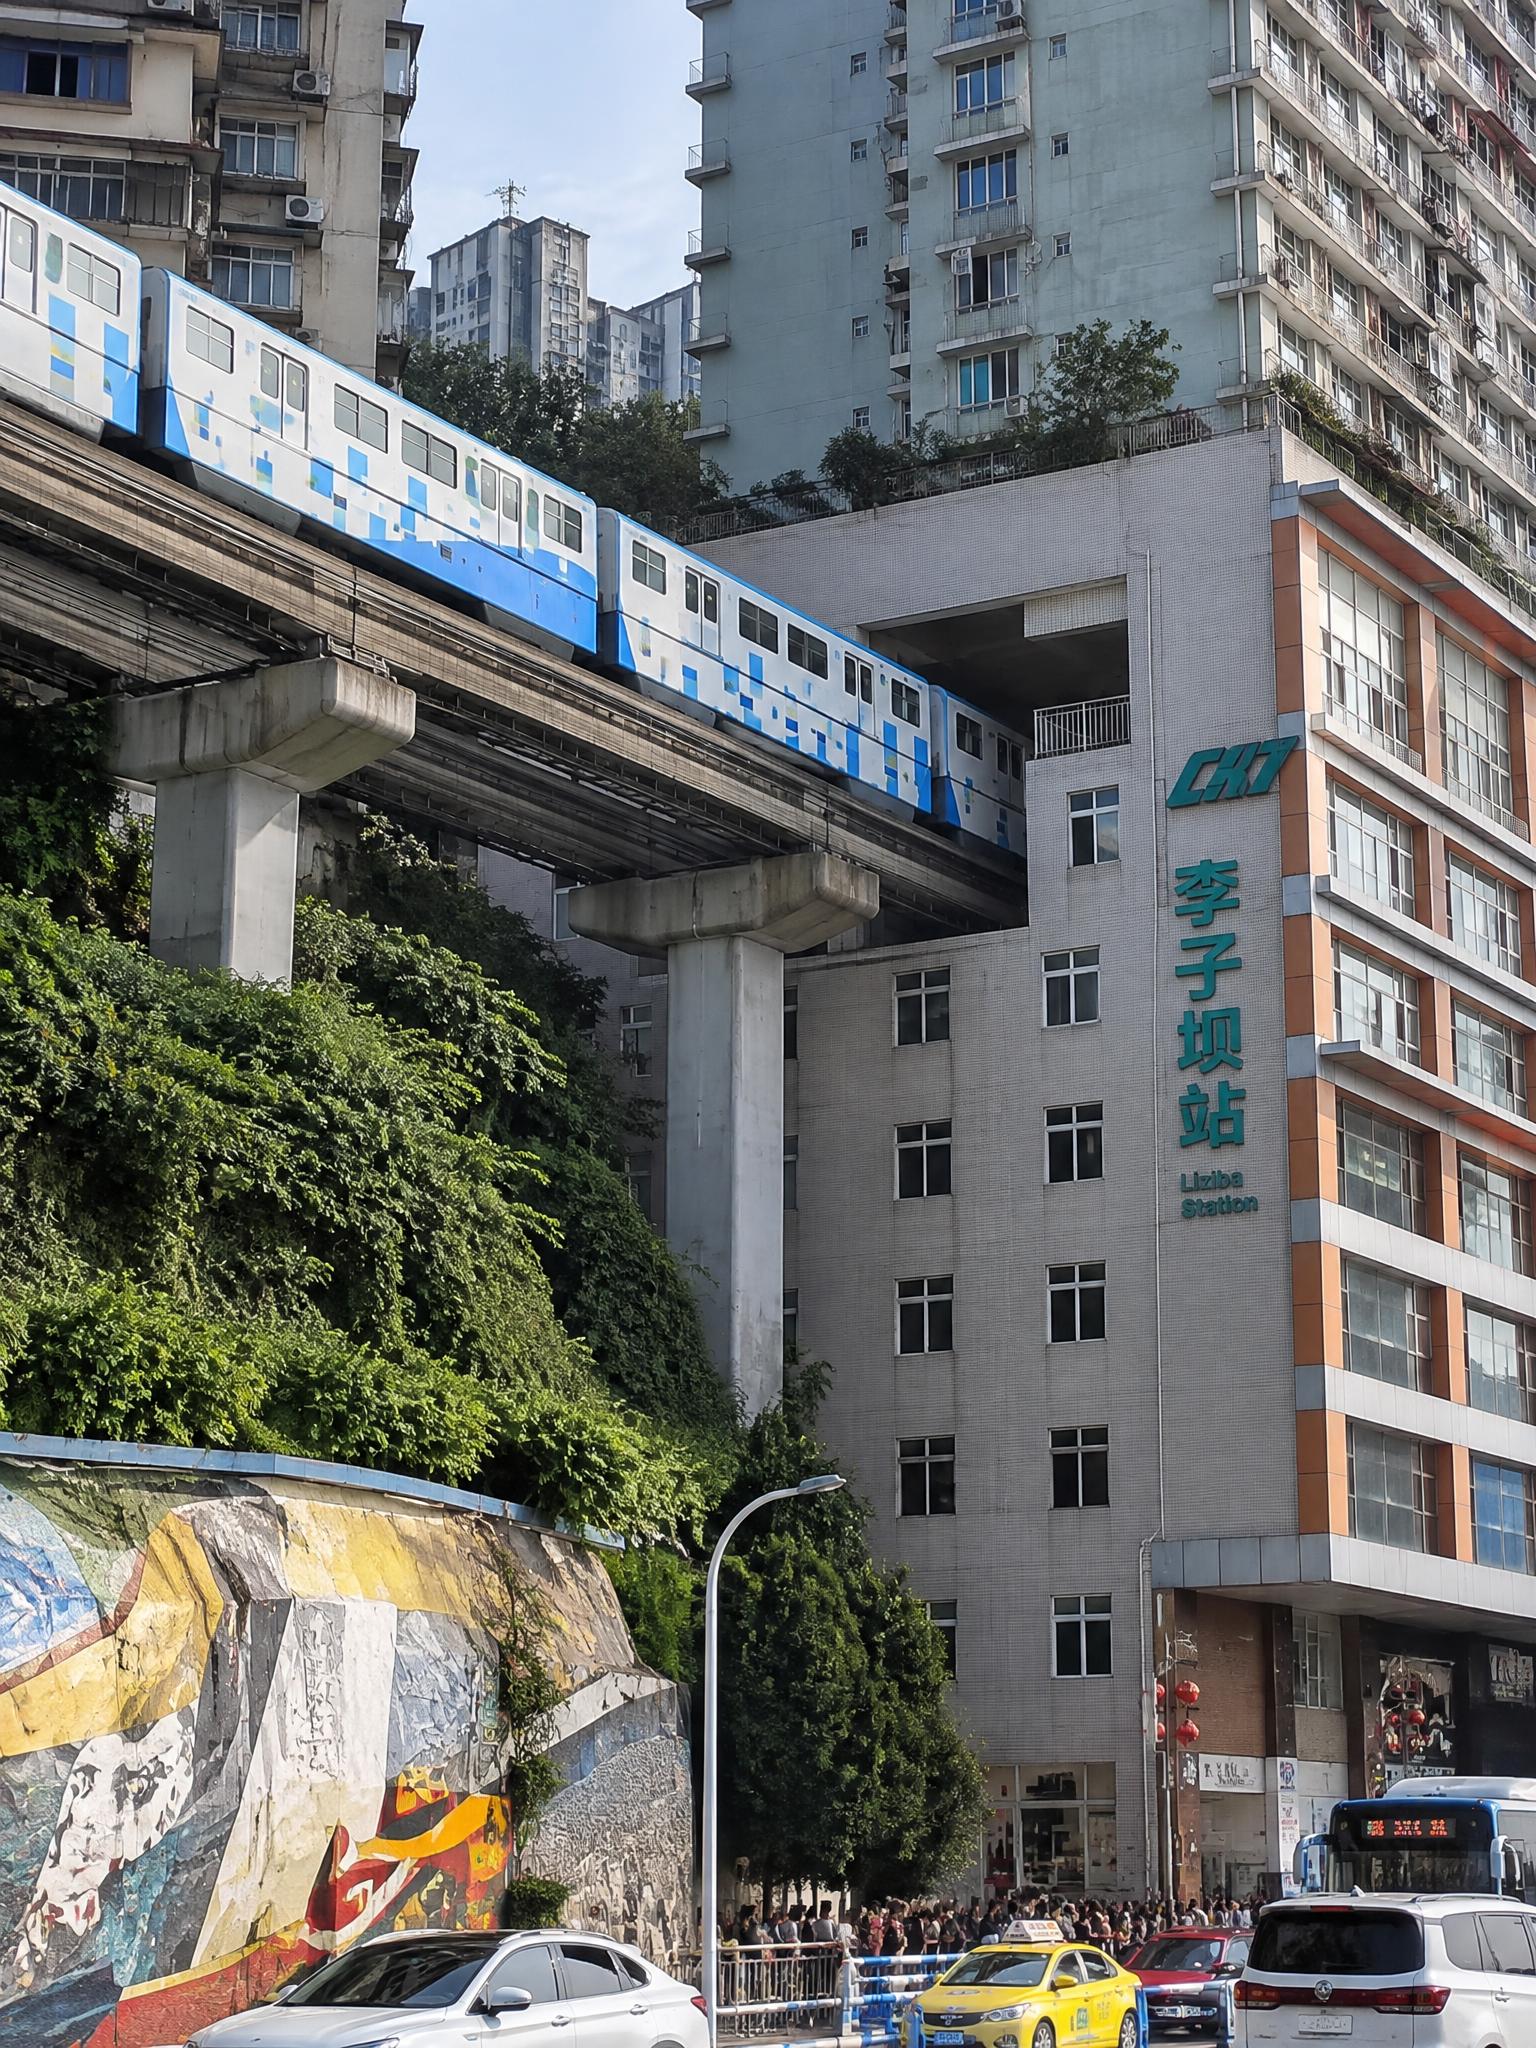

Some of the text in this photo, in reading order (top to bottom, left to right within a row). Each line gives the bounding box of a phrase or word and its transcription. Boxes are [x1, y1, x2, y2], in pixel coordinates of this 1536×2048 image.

[1175, 858, 1246, 1149] 李子坝站
[1180, 1169, 1244, 1193] Liziba
[1181, 1195, 1259, 1219] Station
